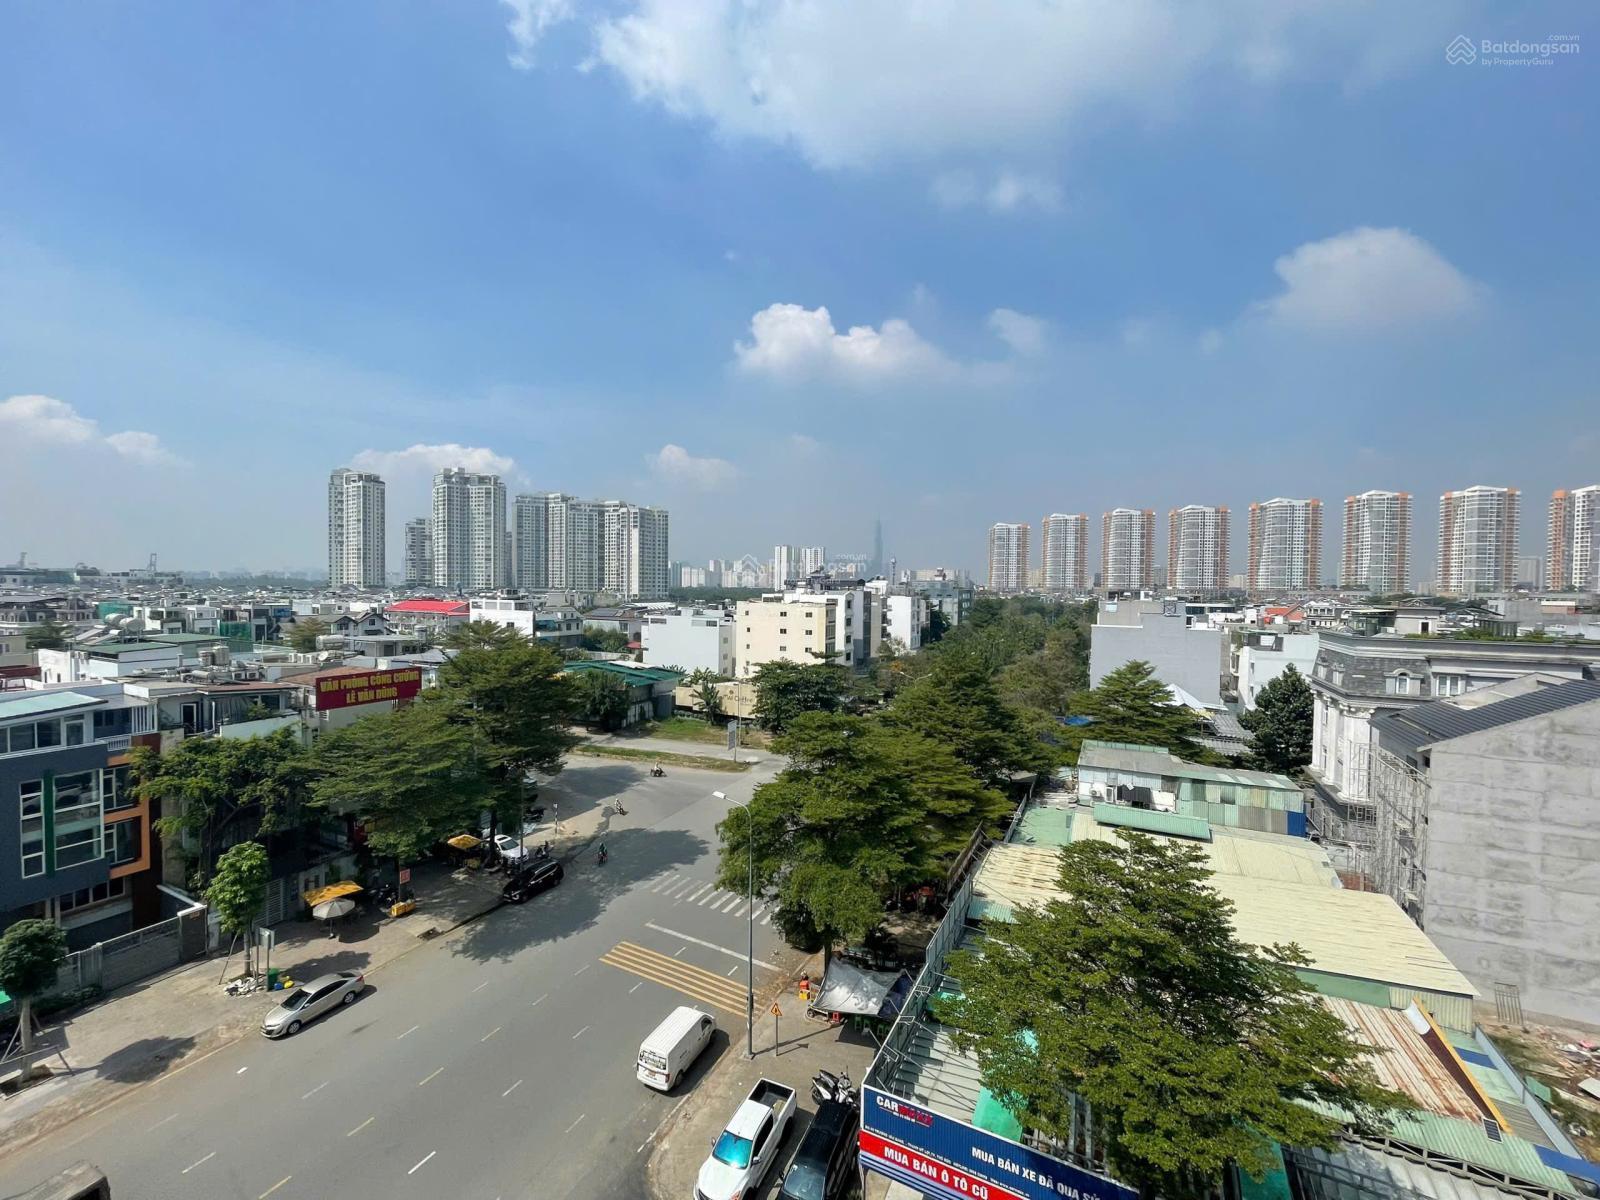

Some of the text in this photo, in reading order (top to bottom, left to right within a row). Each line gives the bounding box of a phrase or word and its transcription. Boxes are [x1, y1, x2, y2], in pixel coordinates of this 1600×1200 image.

[877, 1095, 898, 1112] CAR
[884, 1146, 909, 1167] MUA
[913, 1158, 937, 1178] BÁN
[941, 1169, 949, 1183] Ô
[953, 1176, 968, 1191] TÔ
[972, 1184, 988, 1200] CŨ
[972, 1146, 995, 1165] MUA
[997, 1158, 1020, 1176] BÁN
[1022, 1167, 1036, 1182] XE
[1038, 1174, 1054, 1190] ĐÃ
[1057, 1182, 1080, 1200] QUA
